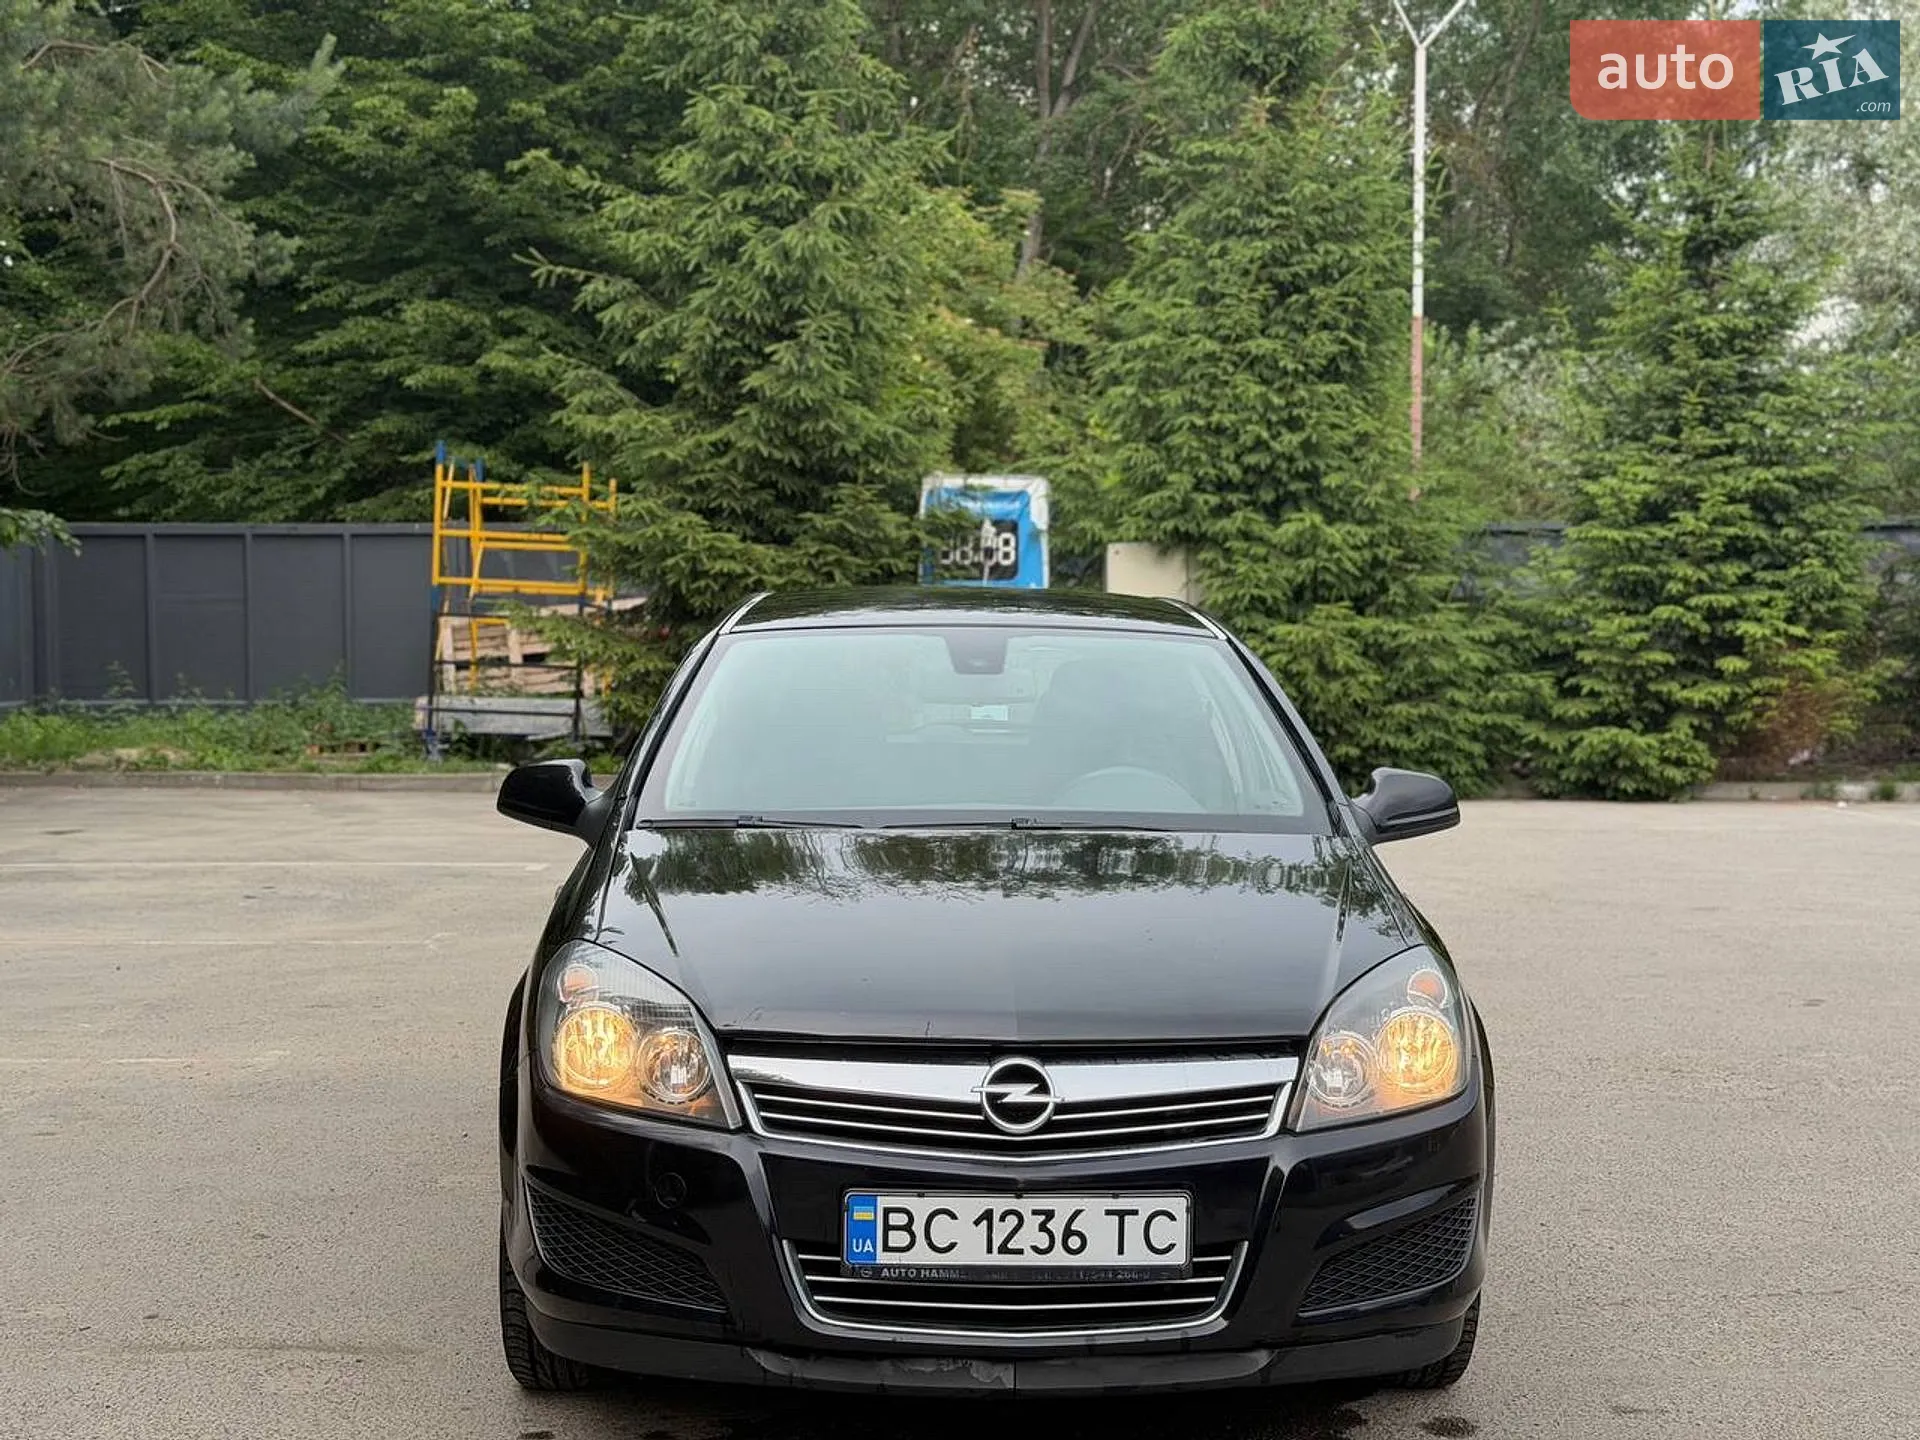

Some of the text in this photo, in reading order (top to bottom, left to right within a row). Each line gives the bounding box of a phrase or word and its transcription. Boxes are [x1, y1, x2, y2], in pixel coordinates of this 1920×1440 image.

[881, 1206, 1177, 1256] BC 1236 TC
[852, 1238, 875, 1254] UA
[881, 1267, 917, 1278] AUTO
